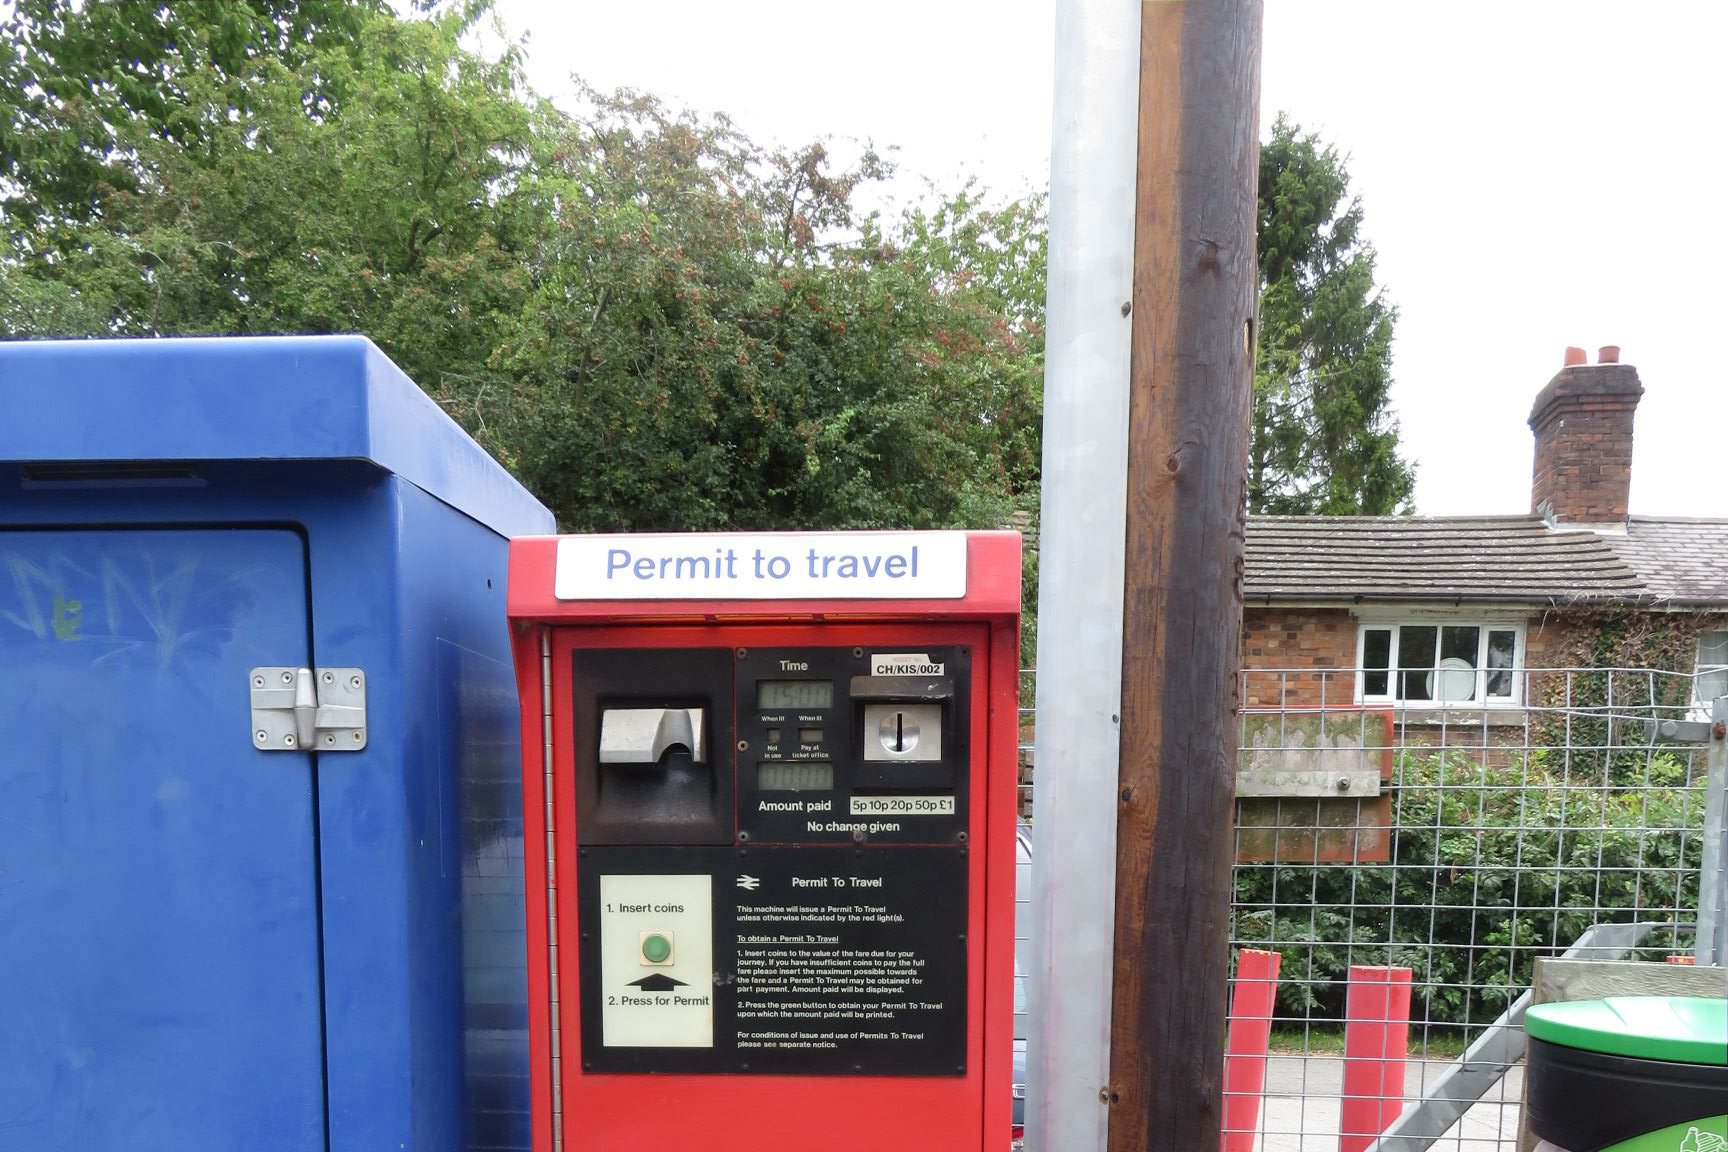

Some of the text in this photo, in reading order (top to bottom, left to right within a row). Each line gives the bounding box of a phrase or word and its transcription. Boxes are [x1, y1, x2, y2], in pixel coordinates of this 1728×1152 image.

[607, 546, 918, 580] Permit to travel
[779, 660, 808, 671] Time
[876, 665, 940, 674] CH/KIS/002
[758, 800, 831, 813] Amount paid
[853, 800, 952, 812] 5p 10p 20p 50p £1
[807, 821, 900, 834] No change given
[792, 877, 882, 887] Permit To Travel
[606, 903, 684, 913] 1. Insert coins
[877, 914, 904, 923] light(s).
[737, 959, 767, 968] journey.
[752, 968, 777, 977] please
[854, 968, 885, 977] possible
[737, 986, 753, 994] part
[755, 986, 790, 994] payment.
[822, 986, 839, 994] paid
[866, 986, 905, 994] displayed.
[608, 996, 710, 1006] 2. Press for Permit
[780, 1003, 802, 1011] green
[823, 1011, 840, 1020] paid
[866, 1011, 895, 1020] printed.
[737, 1041, 761, 1050] please
[779, 1041, 811, 1050] separate
